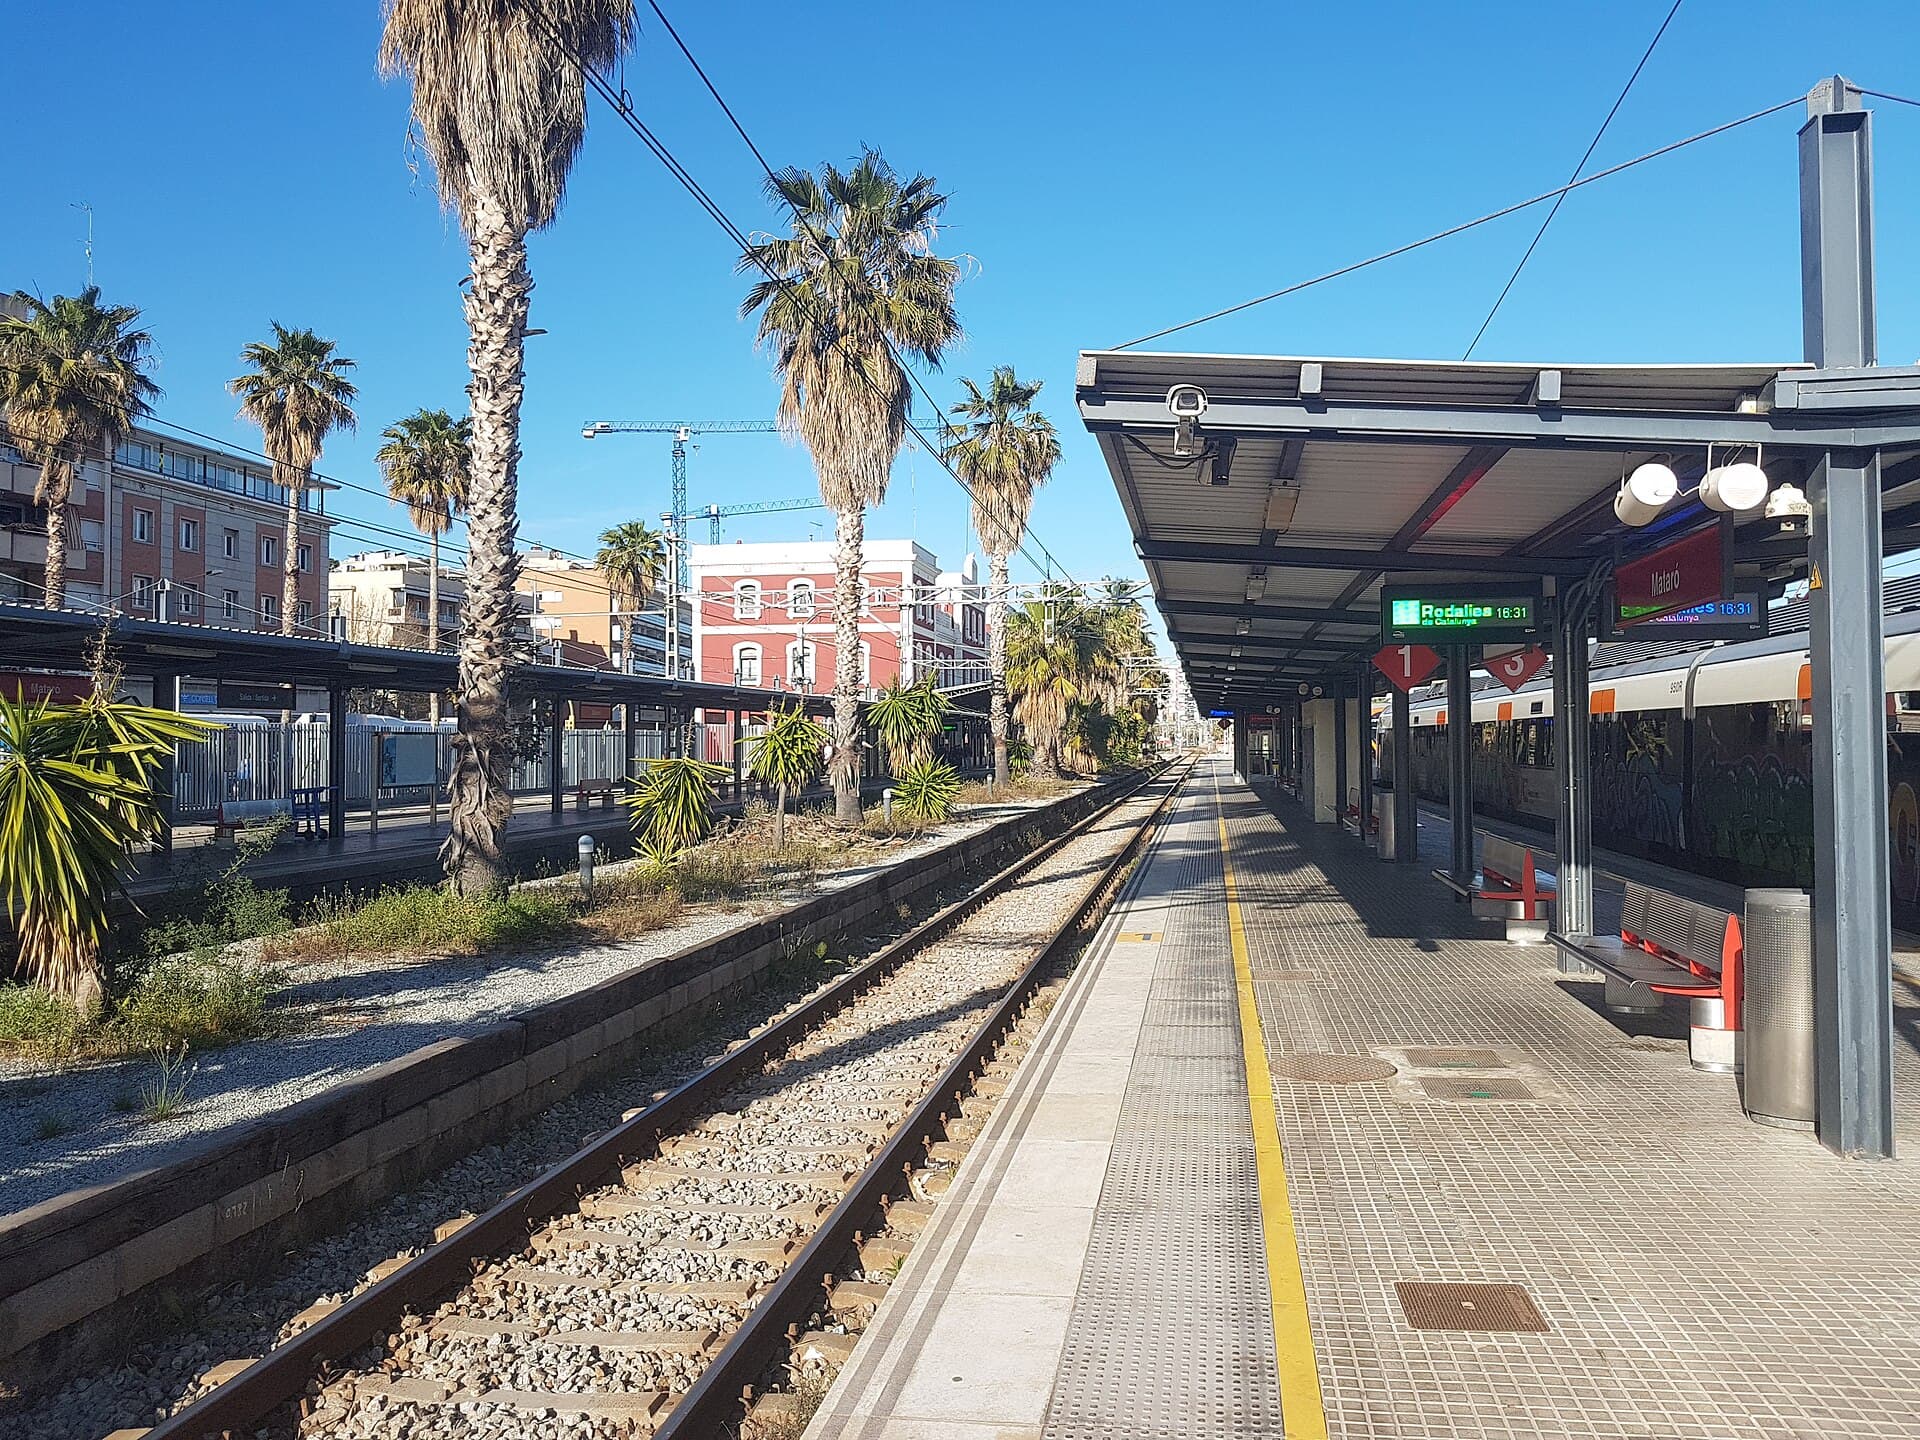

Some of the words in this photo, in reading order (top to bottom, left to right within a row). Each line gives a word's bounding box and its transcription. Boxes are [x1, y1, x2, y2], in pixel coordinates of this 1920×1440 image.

[1651, 562, 1680, 597] Mataró
[1421, 604, 1492, 618] Rodalies
[1496, 607, 1526, 618] 16:31
[1720, 603, 1751, 614] 16:31
[1422, 617, 1433, 626] de
[1435, 617, 1477, 626] Catalunya
[1397, 645, 1411, 677] 1
[1504, 656, 1525, 676] 3
